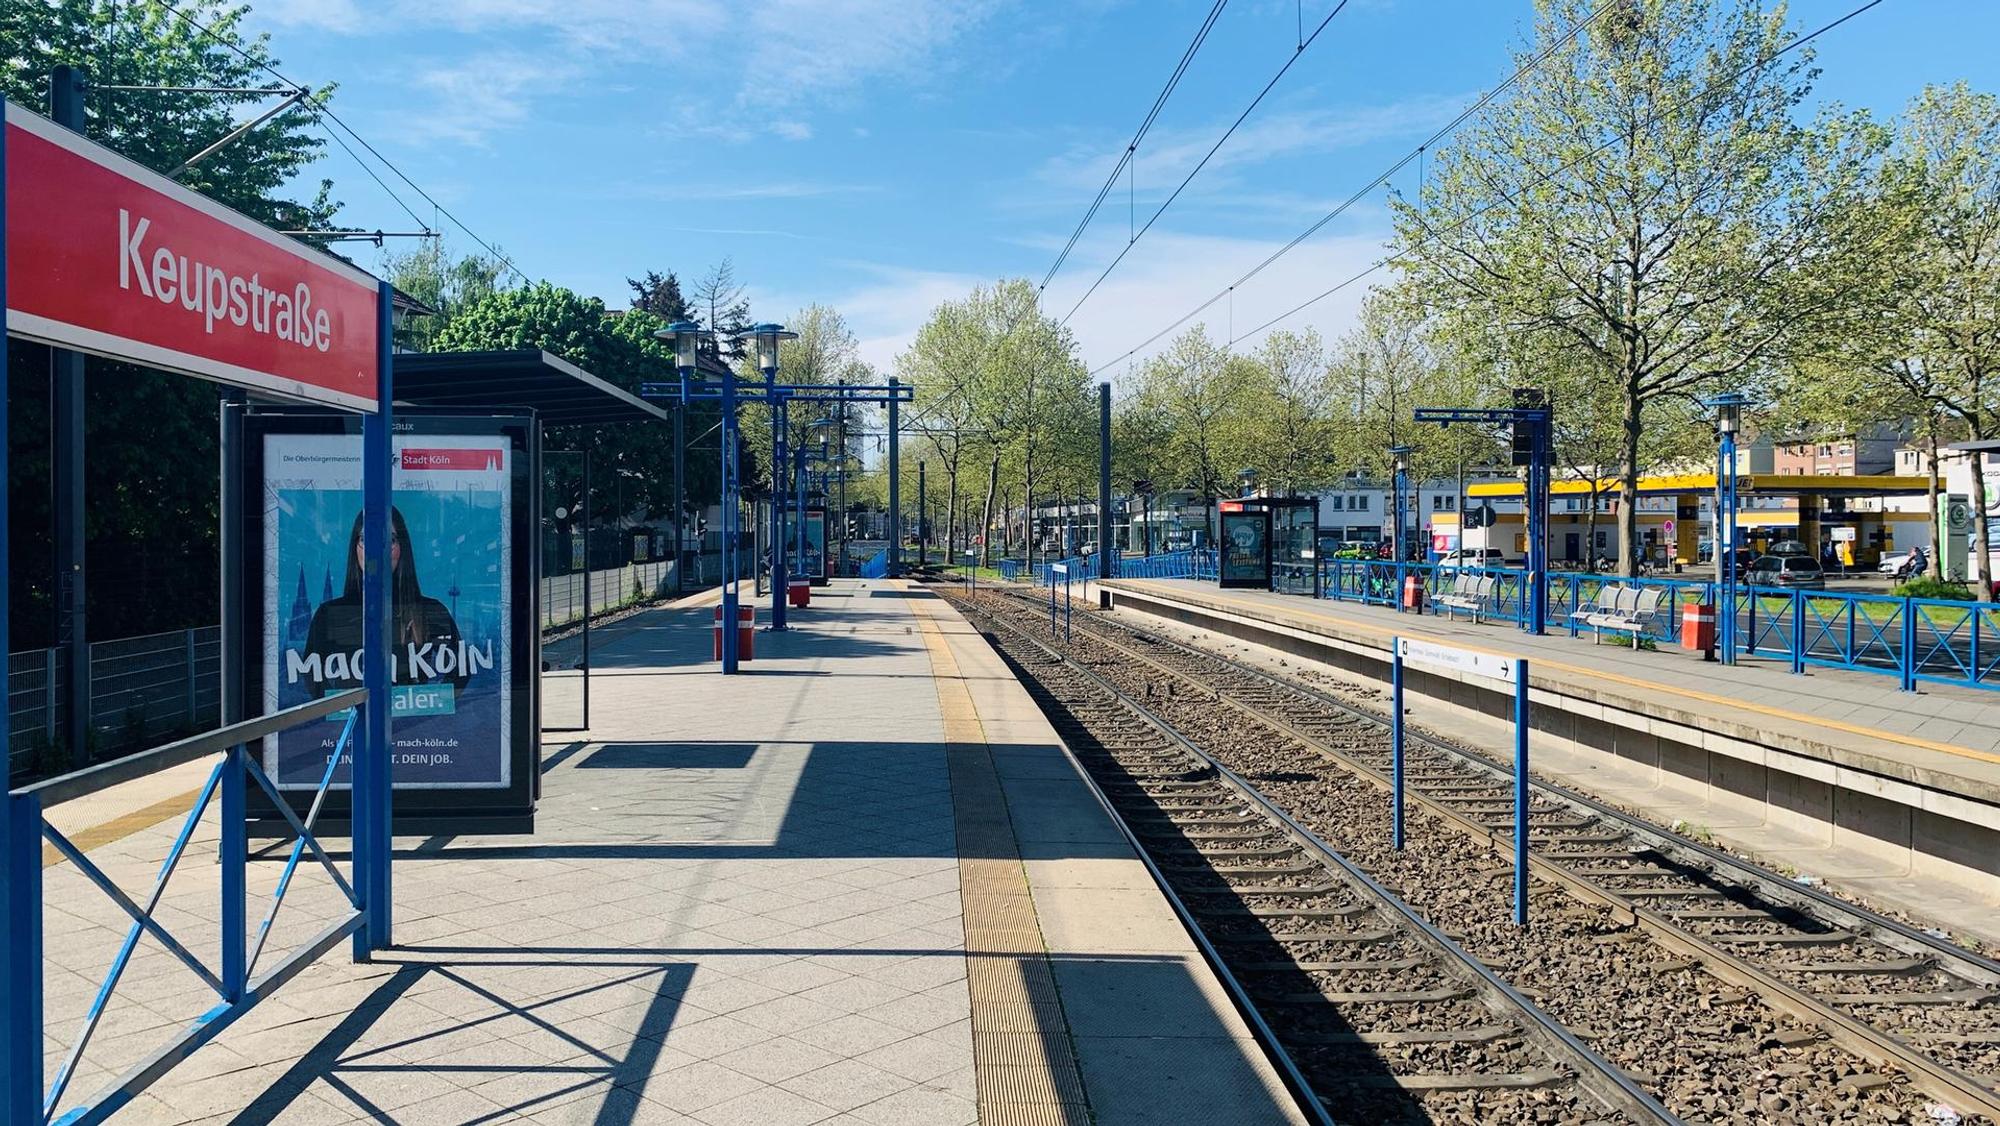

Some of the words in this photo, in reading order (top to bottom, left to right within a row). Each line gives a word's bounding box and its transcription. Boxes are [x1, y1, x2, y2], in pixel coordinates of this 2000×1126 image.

[119, 208, 331, 353] Keupstraße
[295, 455, 361, 464] Oberbürgermeisterin
[403, 456, 428, 465] Stadt
[429, 455, 450, 465] Köln
[320, 739, 335, 748] Als
[396, 739, 459, 748] mach-köln.de
[401, 754, 428, 764] DEIN
[429, 754, 453, 766] JOB.
